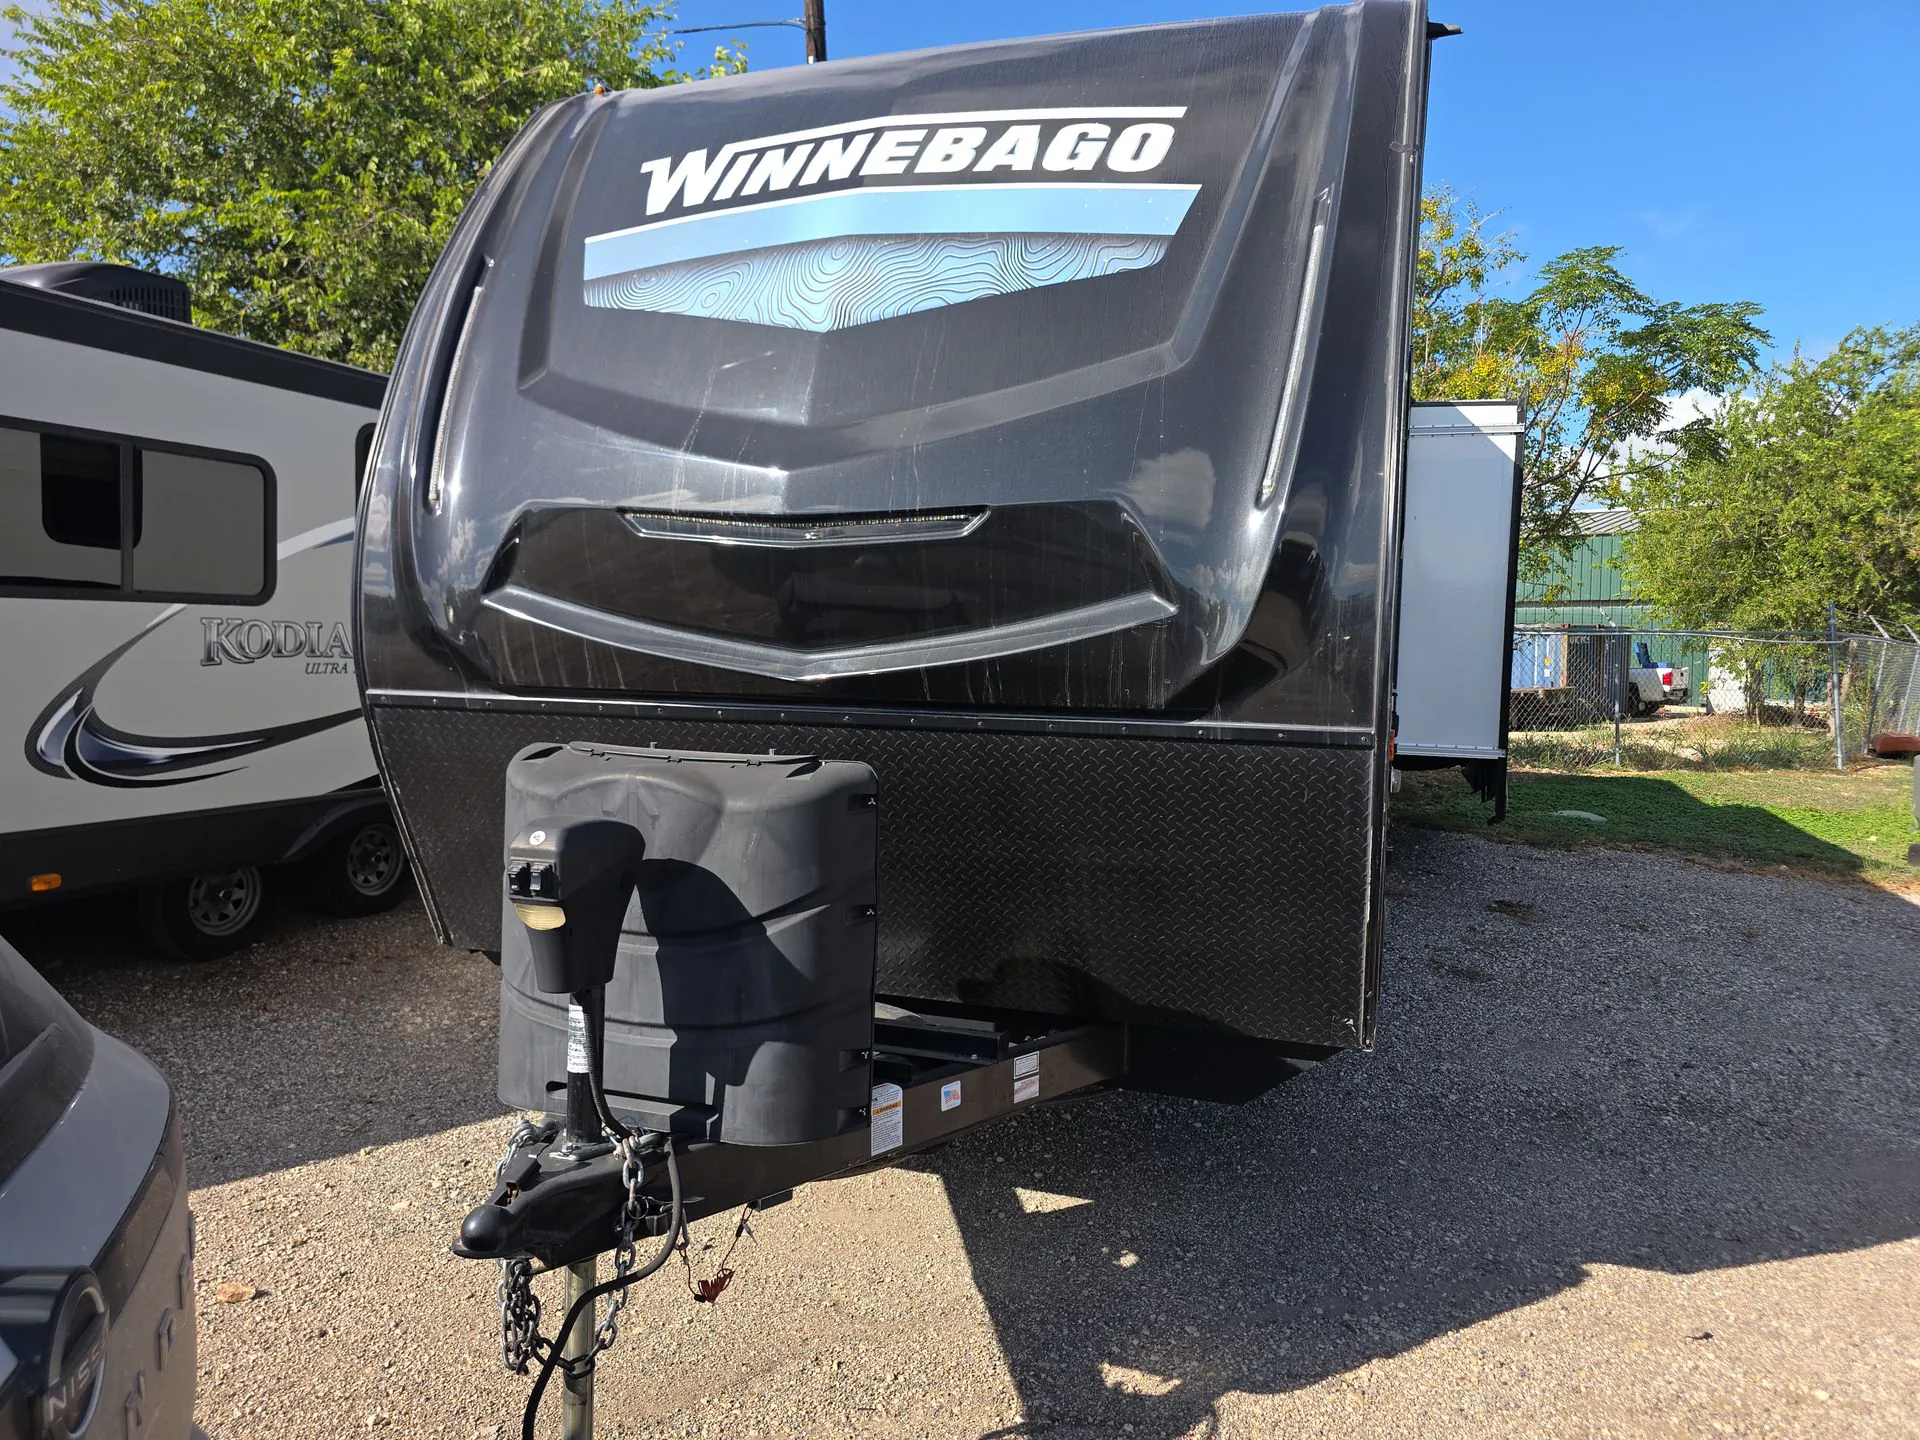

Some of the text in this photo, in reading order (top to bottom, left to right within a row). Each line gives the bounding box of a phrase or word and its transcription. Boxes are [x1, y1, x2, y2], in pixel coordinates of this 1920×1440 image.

[639, 121, 1176, 217] WINNEBAGO
[200, 617, 354, 667] KODIA
[305, 661, 349, 675] ULTRA
[49, 1337, 104, 1422] NISS
